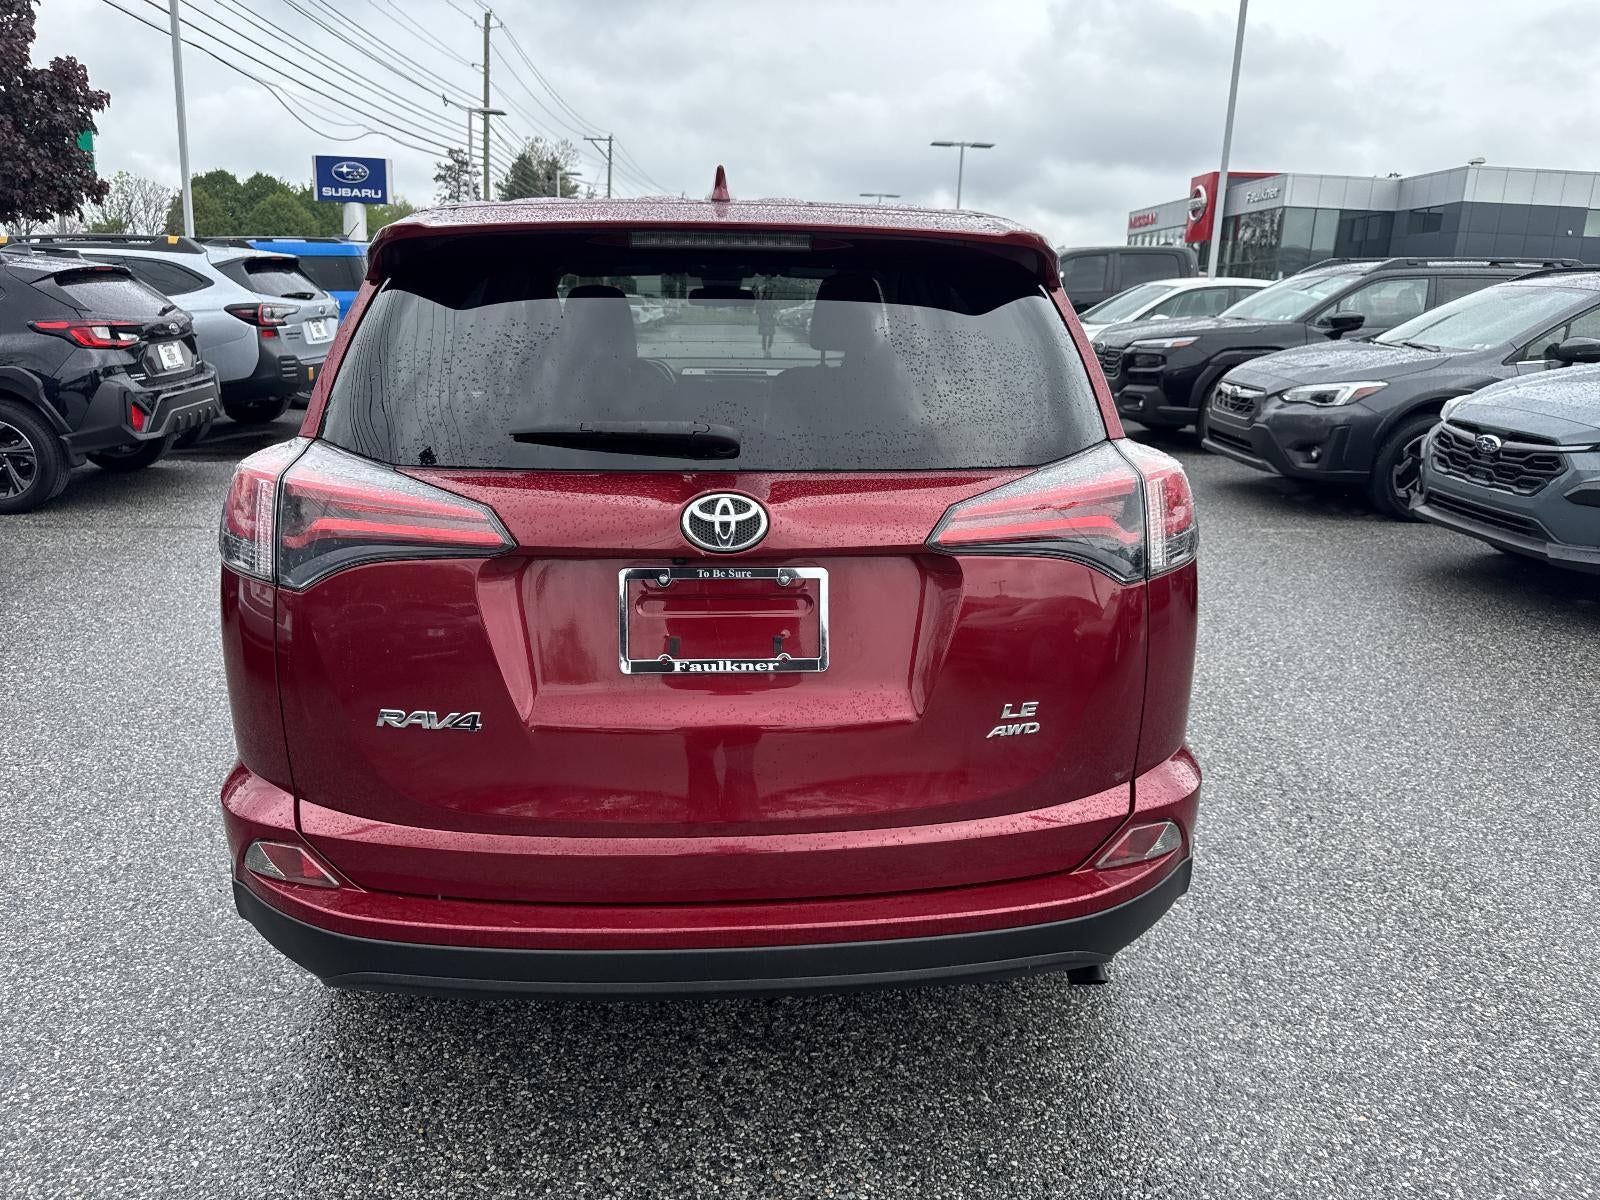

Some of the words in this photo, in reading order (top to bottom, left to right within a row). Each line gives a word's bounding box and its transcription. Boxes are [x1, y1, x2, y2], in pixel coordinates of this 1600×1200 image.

[322, 186, 382, 198] SUBARU
[697, 569, 710, 578] To
[712, 569, 726, 578] Be
[728, 568, 752, 578] Sure
[673, 660, 780, 672] Faulkner
[1001, 701, 1039, 719] LE
[376, 708, 482, 732] RAV4
[986, 722, 1041, 738] AWD
